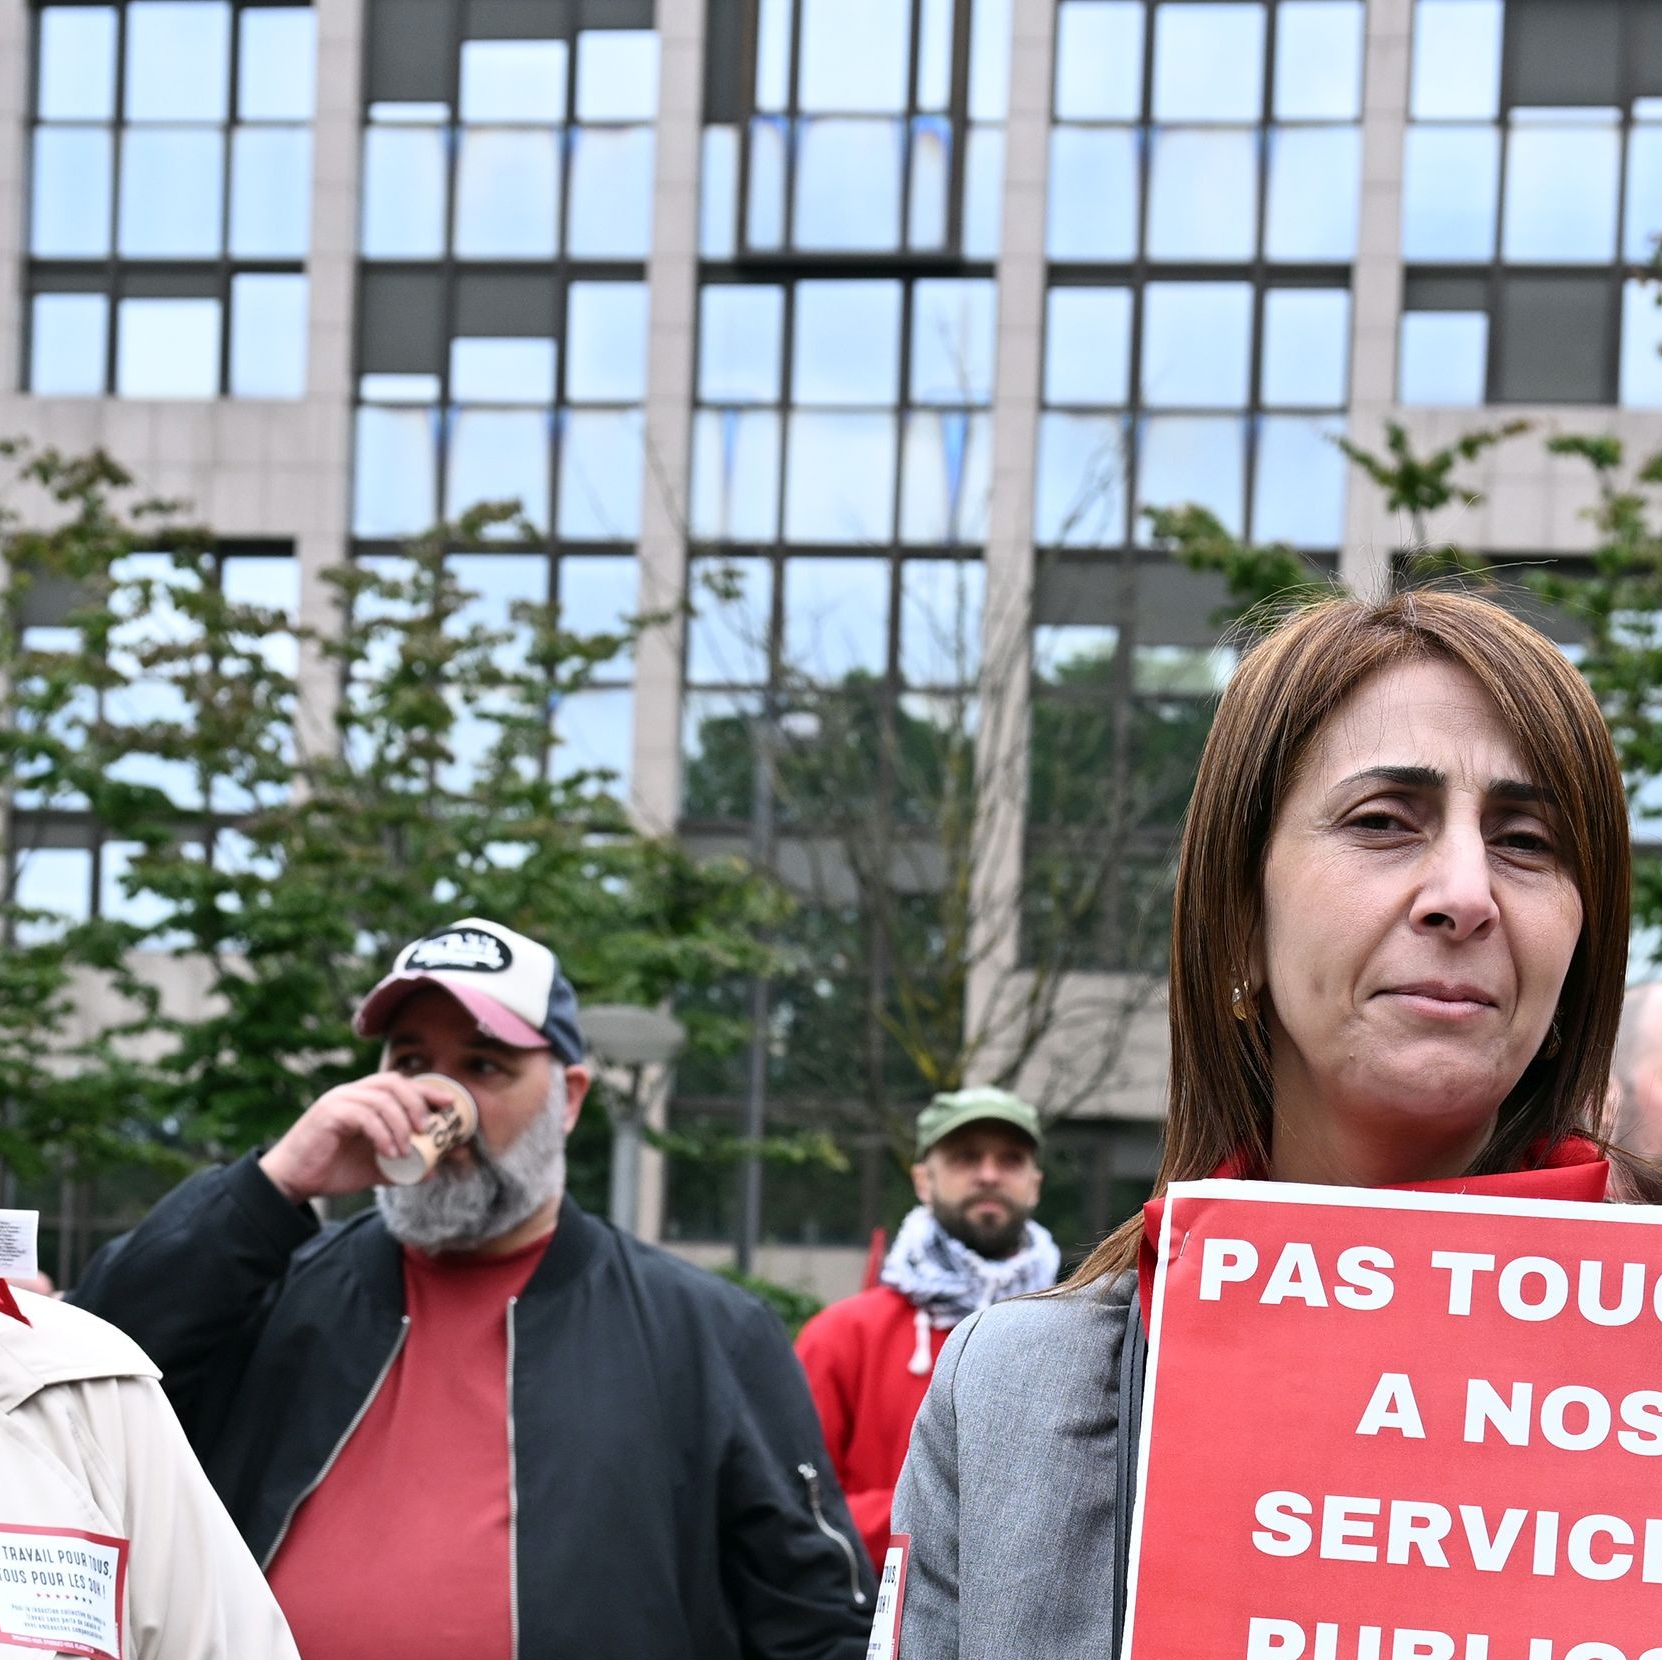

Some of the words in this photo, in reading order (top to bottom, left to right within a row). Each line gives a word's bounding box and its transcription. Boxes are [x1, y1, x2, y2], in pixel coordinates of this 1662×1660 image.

[1198, 1237, 1395, 1312] PAS
[1355, 1373, 1426, 1439] A
[2, 1546, 55, 1565] TRAVAIL
[58, 1550, 87, 1567] POUR
[88, 1554, 113, 1580] TOUS,
[31, 1571, 65, 1587] POUR
[68, 1574, 86, 1590] LES
